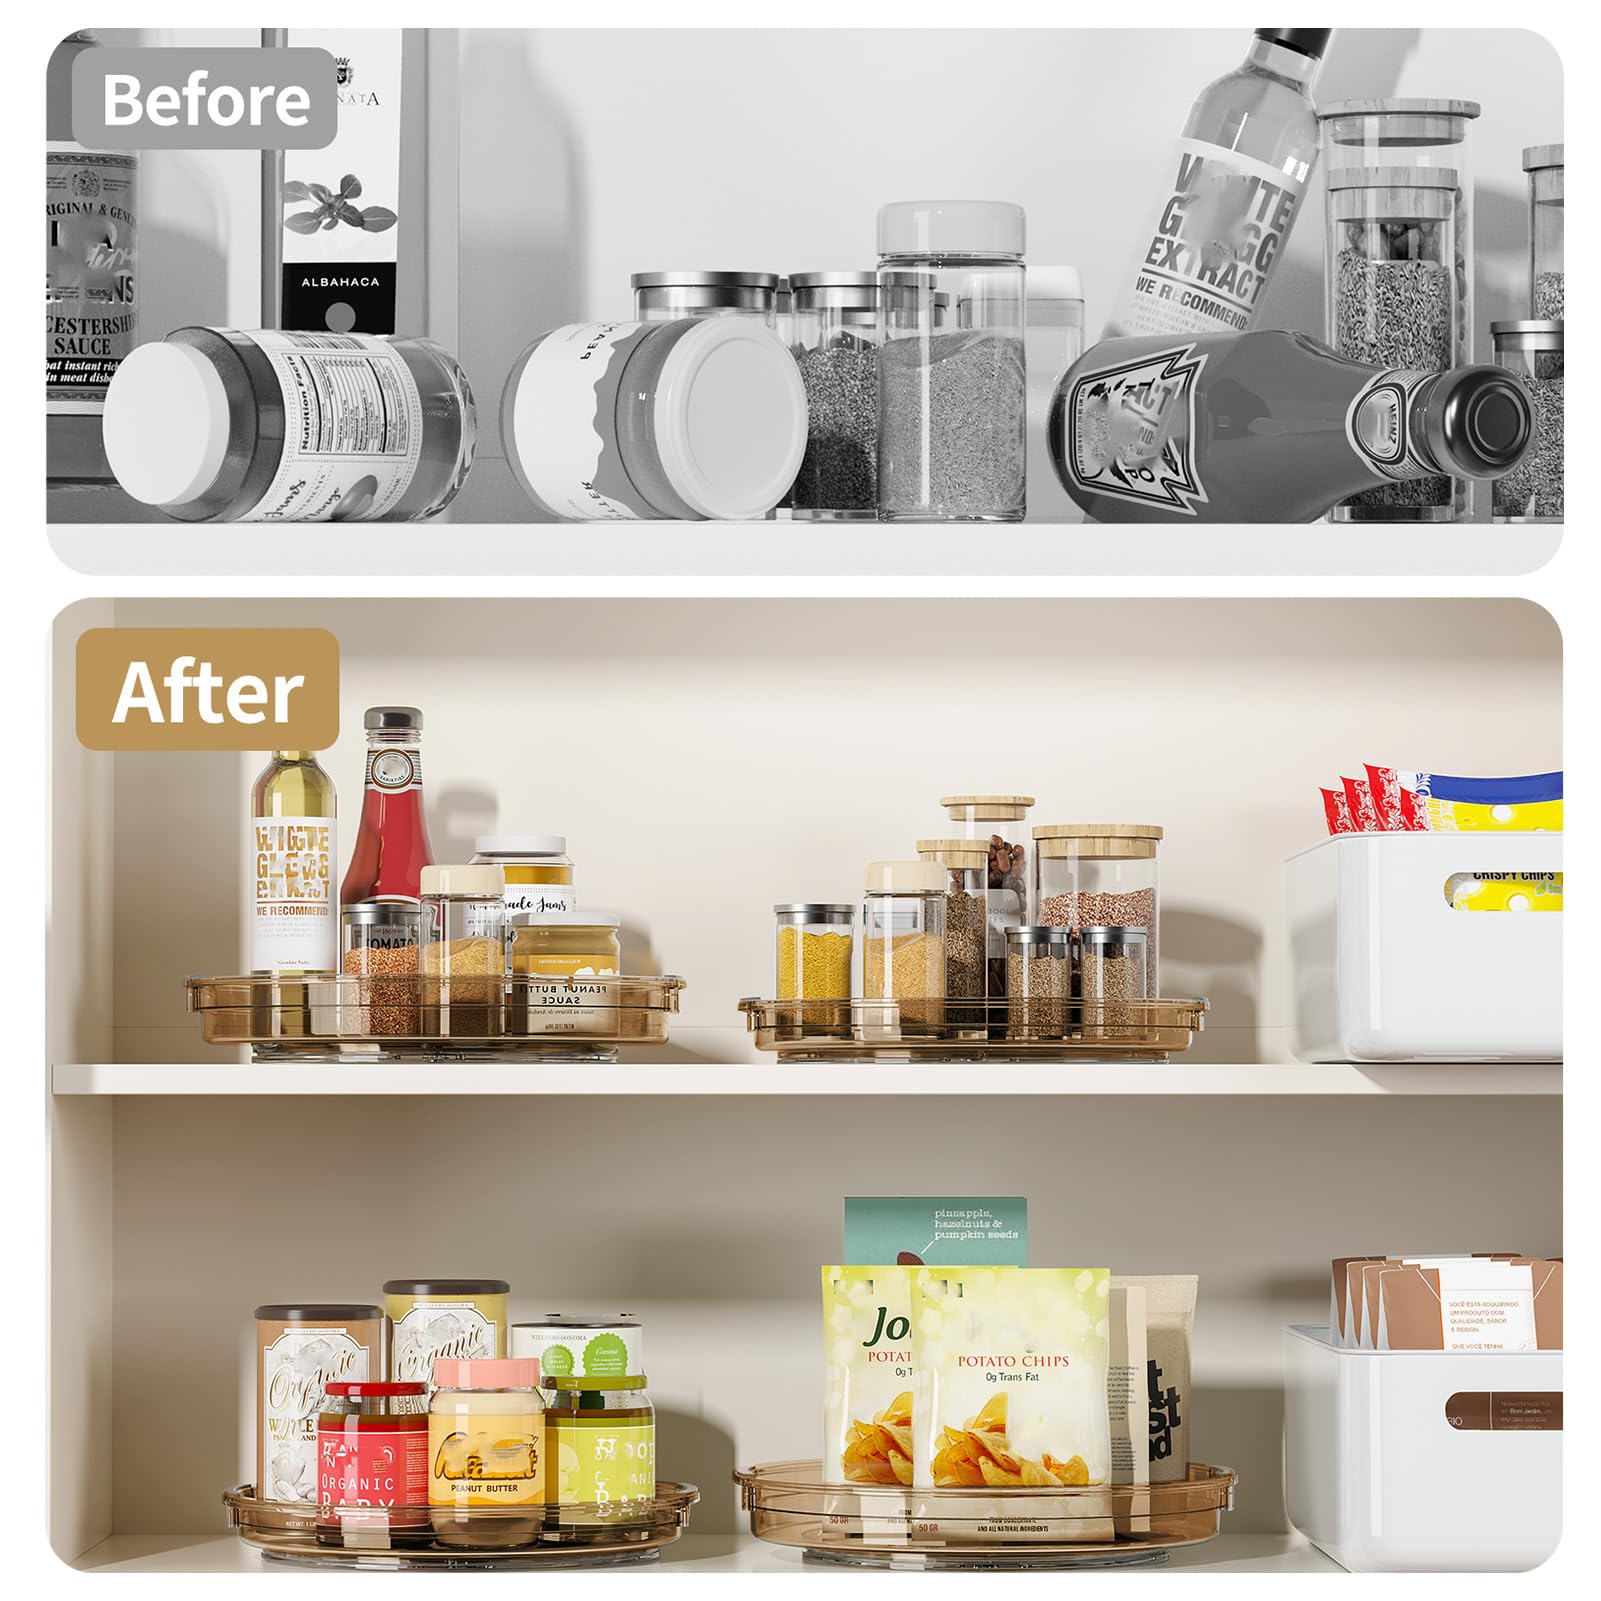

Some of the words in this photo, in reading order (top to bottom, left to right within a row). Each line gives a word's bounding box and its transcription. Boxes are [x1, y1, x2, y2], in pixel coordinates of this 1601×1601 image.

[99, 203, 107, 216] &
[302, 277, 380, 287] ALBAHACA
[1136, 276, 1156, 295] WE
[54, 337, 111, 355] SAUCE
[64, 361, 102, 371] instant
[287, 355, 304, 387] Facts
[60, 373, 88, 383] meat
[301, 390, 310, 451] Nutrition
[536, 896, 567, 912] Jams
[256, 906, 267, 916] WE
[935, 1209, 993, 1219] pineapple,
[935, 1219, 991, 1228] hazelnuts
[992, 1220, 1003, 1228] &
[935, 1230, 985, 1241] pumpkin
[988, 1230, 1019, 1239] seeds
[862, 1306, 912, 1347] Jo
[868, 1351, 912, 1362] POTAT
[958, 1356, 1016, 1368] POTATO
[1022, 1356, 1069, 1368] CHIPS
[896, 1367, 907, 1378] 0g
[986, 1372, 997, 1383] 0g
[1000, 1372, 1023, 1382] Trans
[1025, 1372, 1039, 1382] Fat
[322, 1473, 394, 1490] ORGANIC
[451, 1484, 482, 1493] PEANUT
[486, 1484, 518, 1493] BUTTER
[918, 1524, 928, 1533] 50
[929, 1524, 938, 1533] GR
